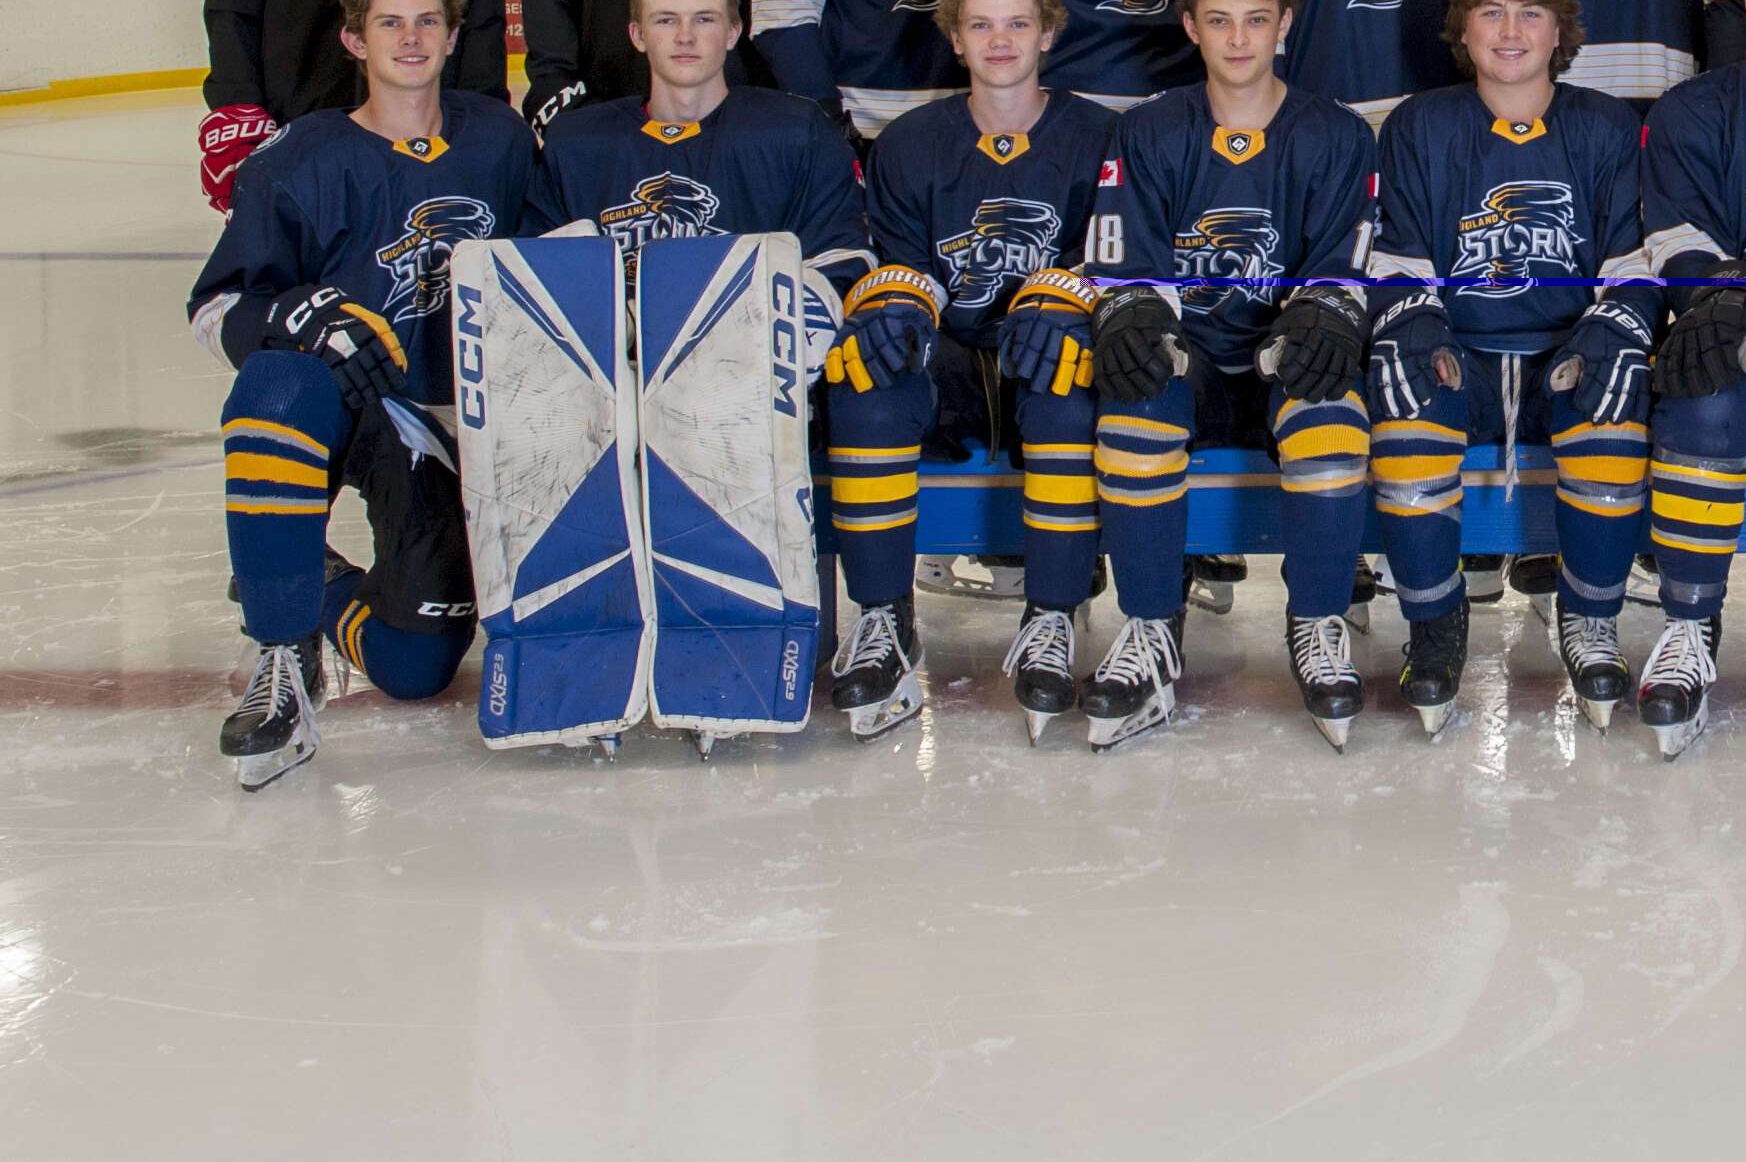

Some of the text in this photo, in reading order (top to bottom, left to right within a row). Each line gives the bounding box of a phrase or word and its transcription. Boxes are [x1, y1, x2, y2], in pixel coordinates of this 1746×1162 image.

[205, 118, 278, 149] BAUE
[941, 237, 974, 255] HIGHL
[1084, 214, 1125, 266] 18
[286, 286, 347, 335] CC
[1372, 292, 1446, 336] BAUE
[1582, 303, 1652, 346] AUER
[456, 284, 485, 430] CCM
[772, 270, 798, 419] CCM
